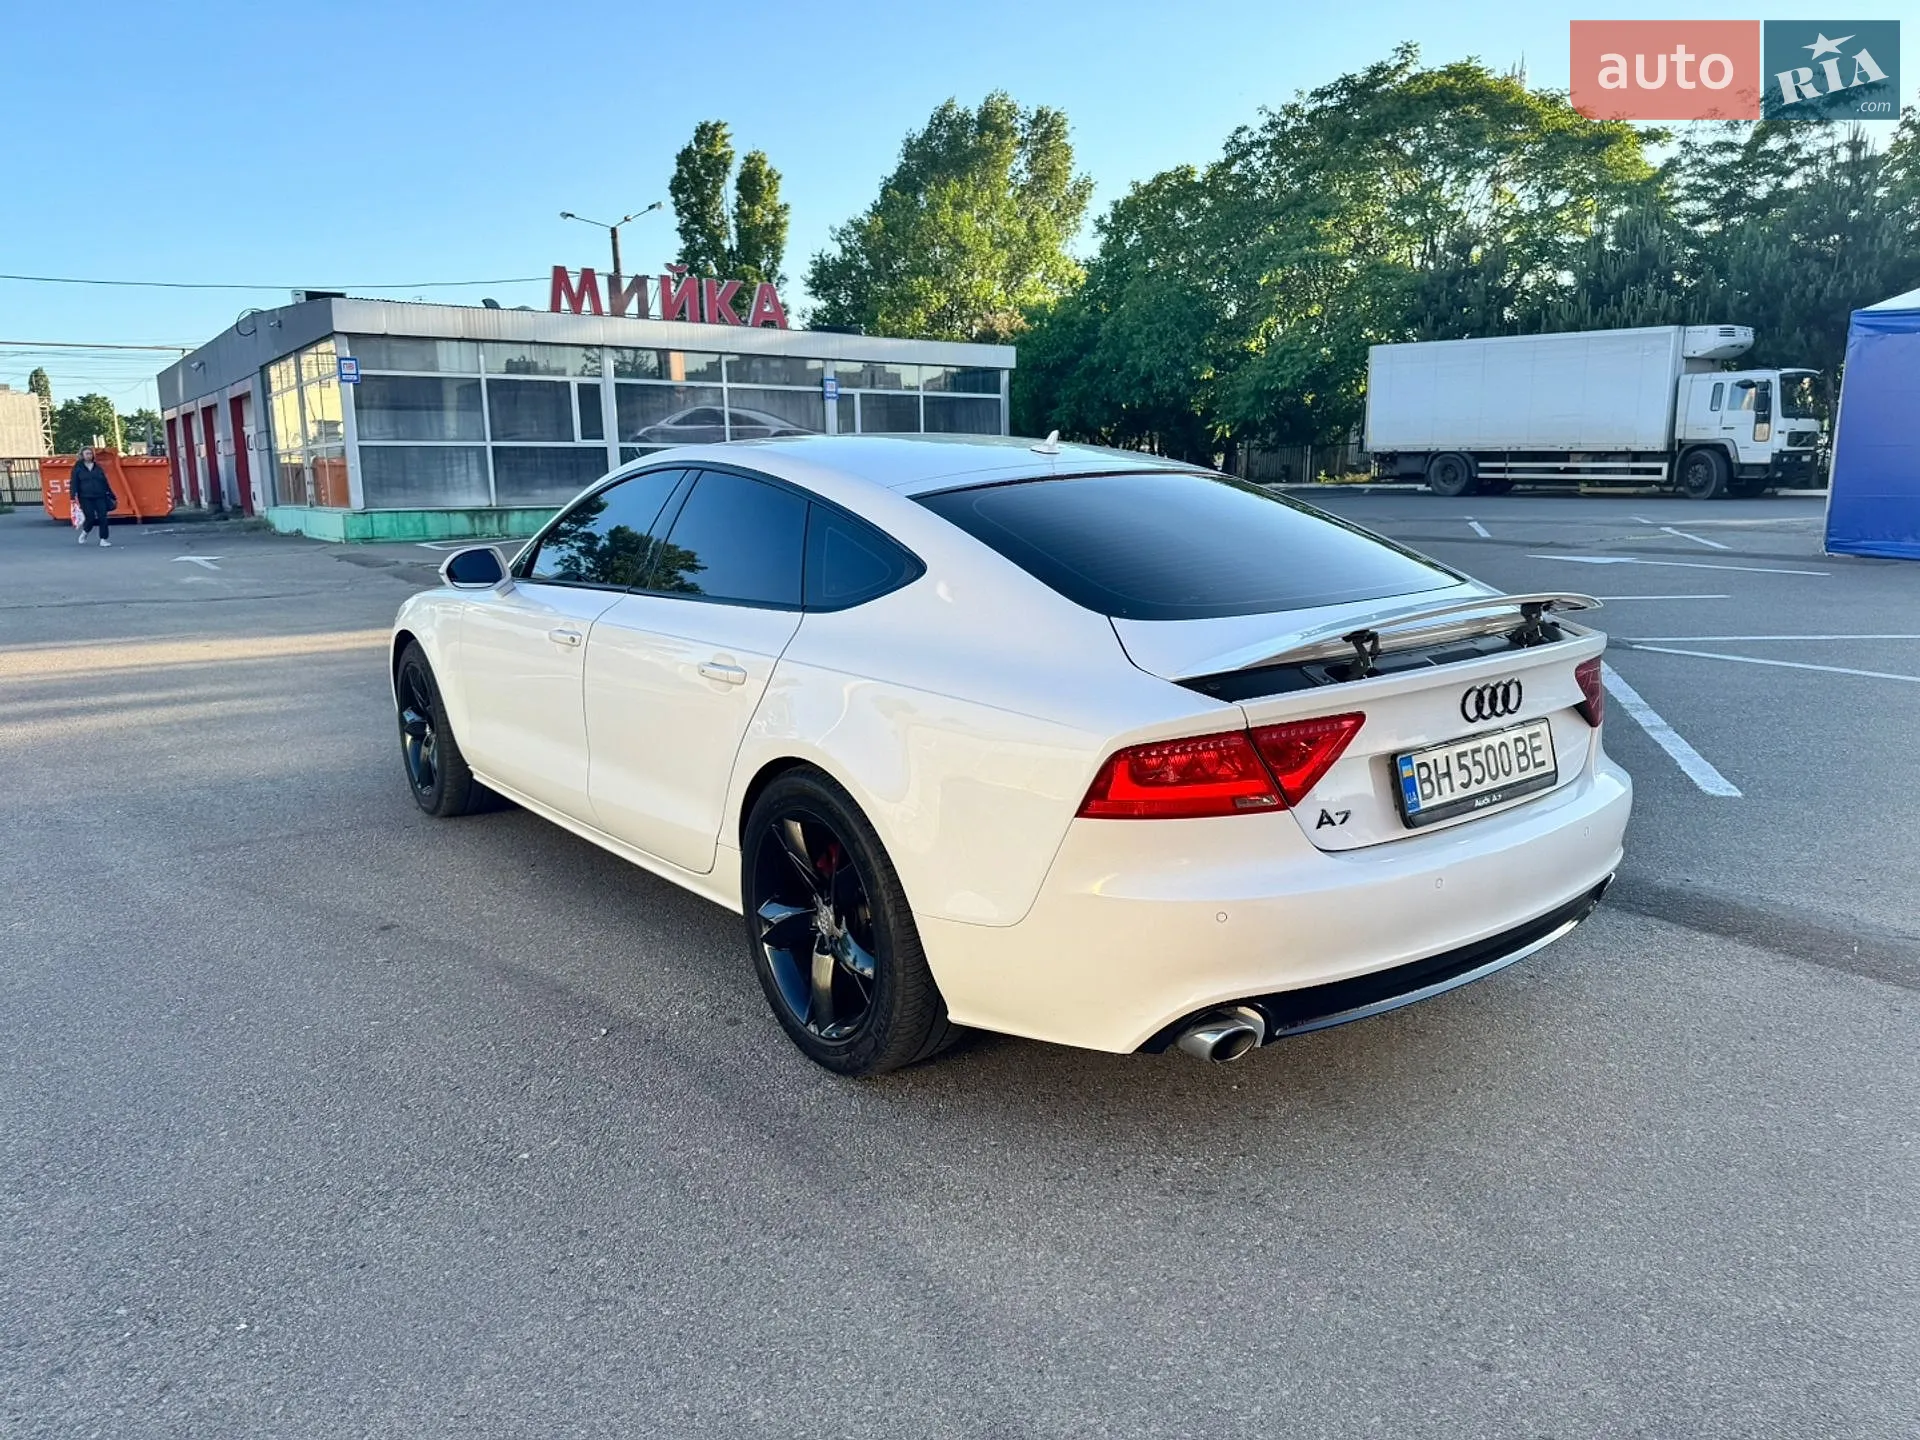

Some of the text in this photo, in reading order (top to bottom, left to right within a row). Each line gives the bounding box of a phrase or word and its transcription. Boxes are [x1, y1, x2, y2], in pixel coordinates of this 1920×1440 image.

[550, 263, 788, 329] МИЙКА
[1416, 731, 1546, 801] BH 5500 BE
[1316, 809, 1351, 829] A7
